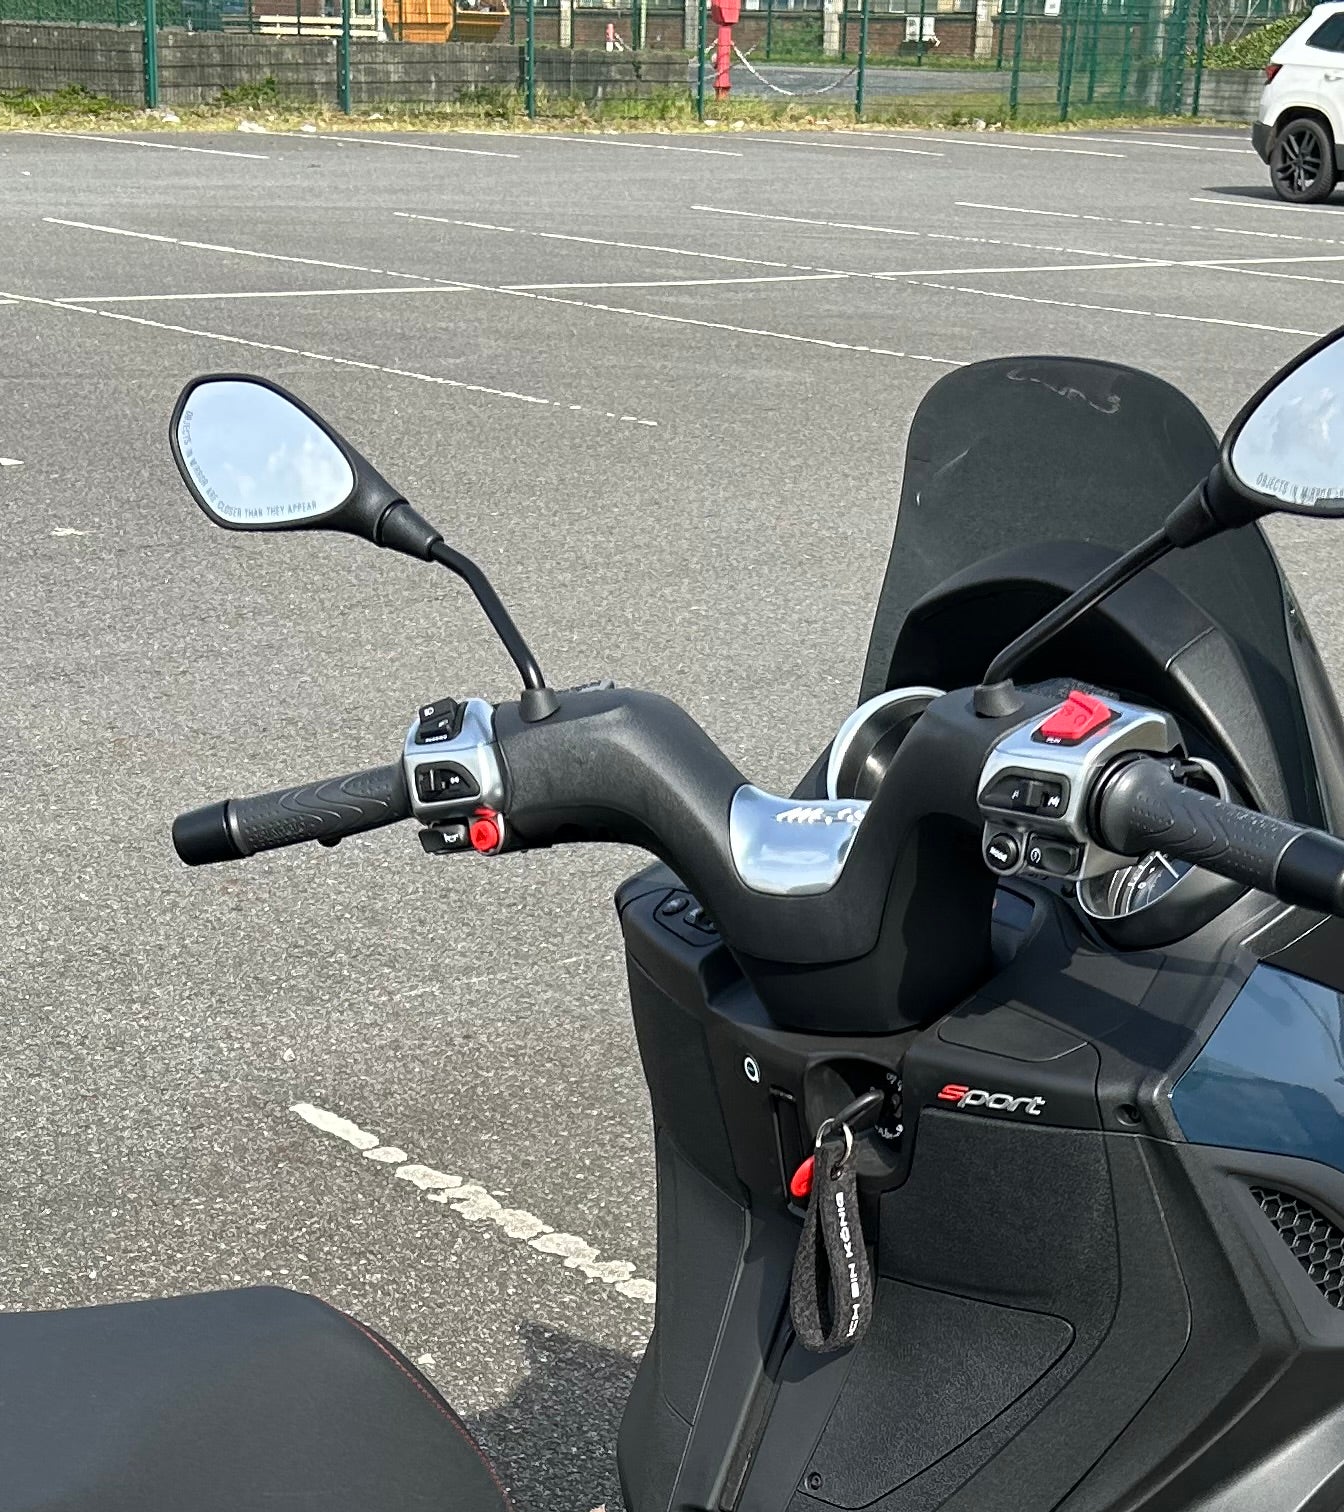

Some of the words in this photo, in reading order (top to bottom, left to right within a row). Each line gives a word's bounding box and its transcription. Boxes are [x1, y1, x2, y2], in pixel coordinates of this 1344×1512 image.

[1256, 472, 1290, 494] OBJECTS
[218, 501, 242, 518] CLOSER
[244, 507, 263, 519] THAN
[266, 504, 285, 516] THEY
[287, 499, 317, 514] APPEAR
[847, 1263, 860, 1299] BIN
[845, 1303, 860, 1338] ICH
